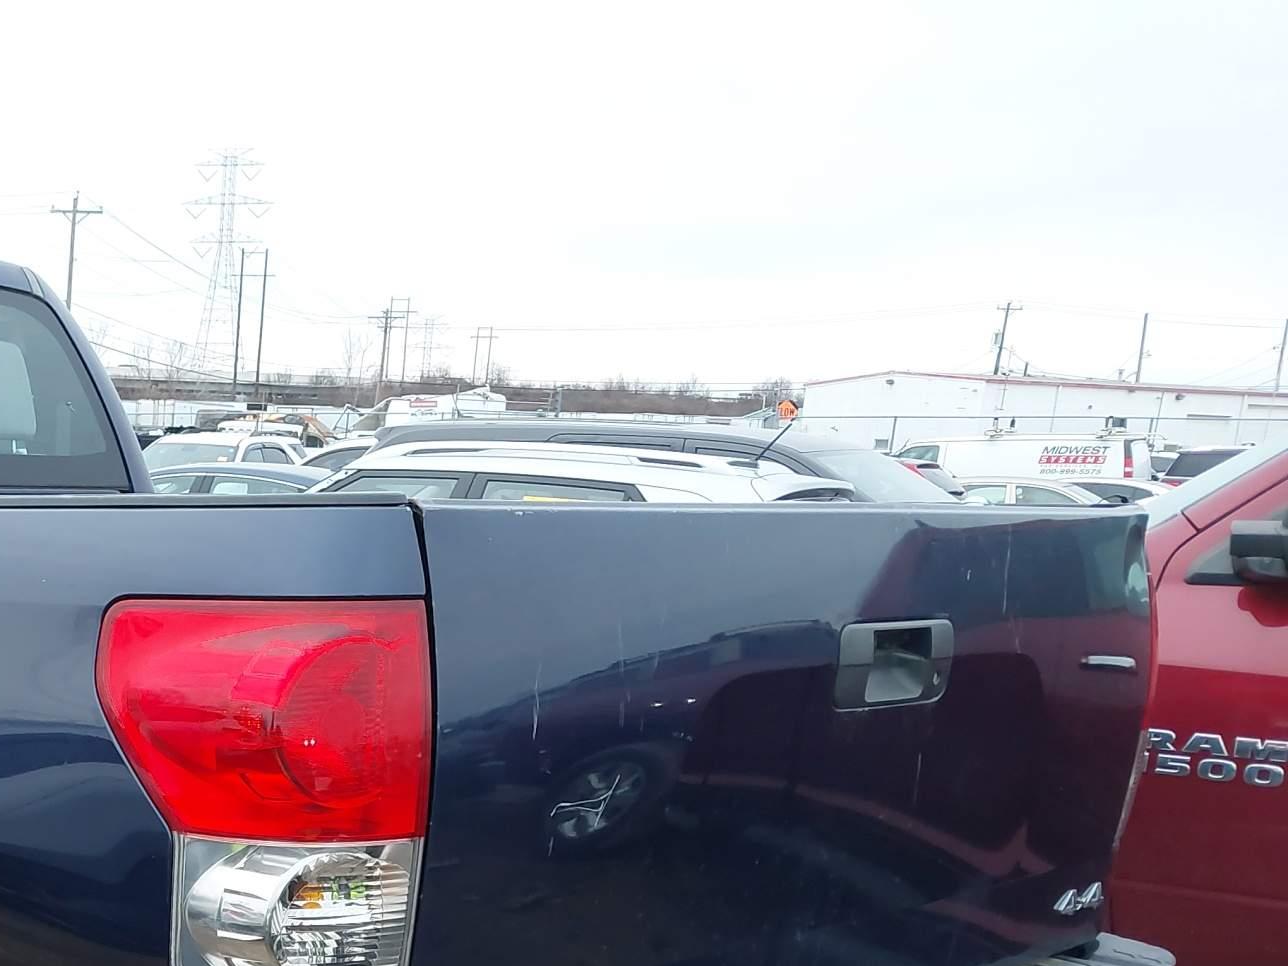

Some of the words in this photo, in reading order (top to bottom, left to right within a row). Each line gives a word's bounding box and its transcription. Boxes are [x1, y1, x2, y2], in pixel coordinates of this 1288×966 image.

[1041, 446, 1111, 455] MIDWEST
[1039, 455, 1107, 464] SYSTEMS
[1146, 728, 1288, 763] RAM
